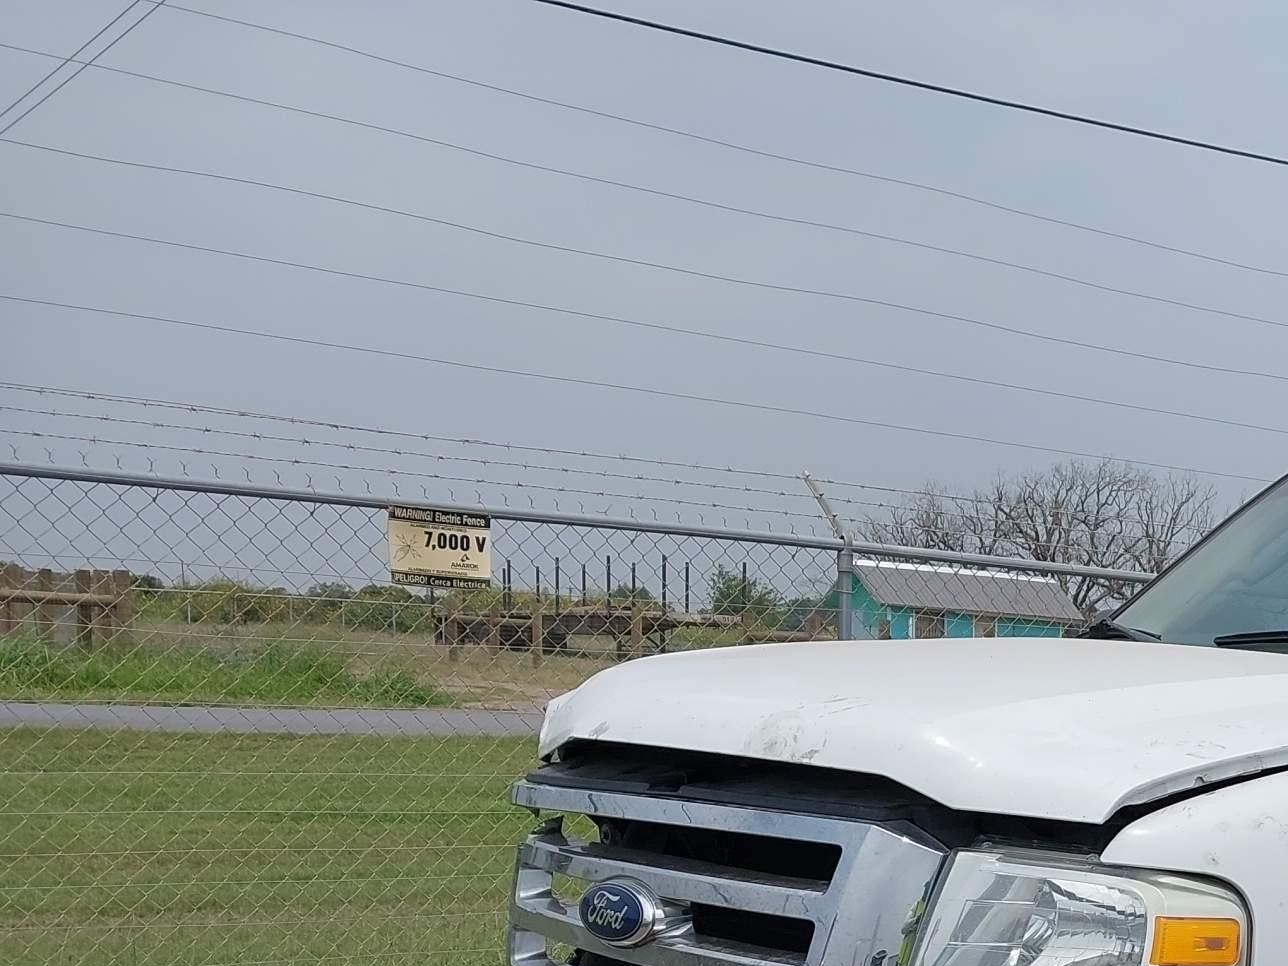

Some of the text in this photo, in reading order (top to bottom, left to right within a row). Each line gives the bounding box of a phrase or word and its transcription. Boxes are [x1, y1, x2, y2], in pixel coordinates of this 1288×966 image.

[394, 507, 486, 527] WARNING! Electric Fence
[424, 530, 487, 553] 7,000 V
[587, 890, 628, 930] Ford
